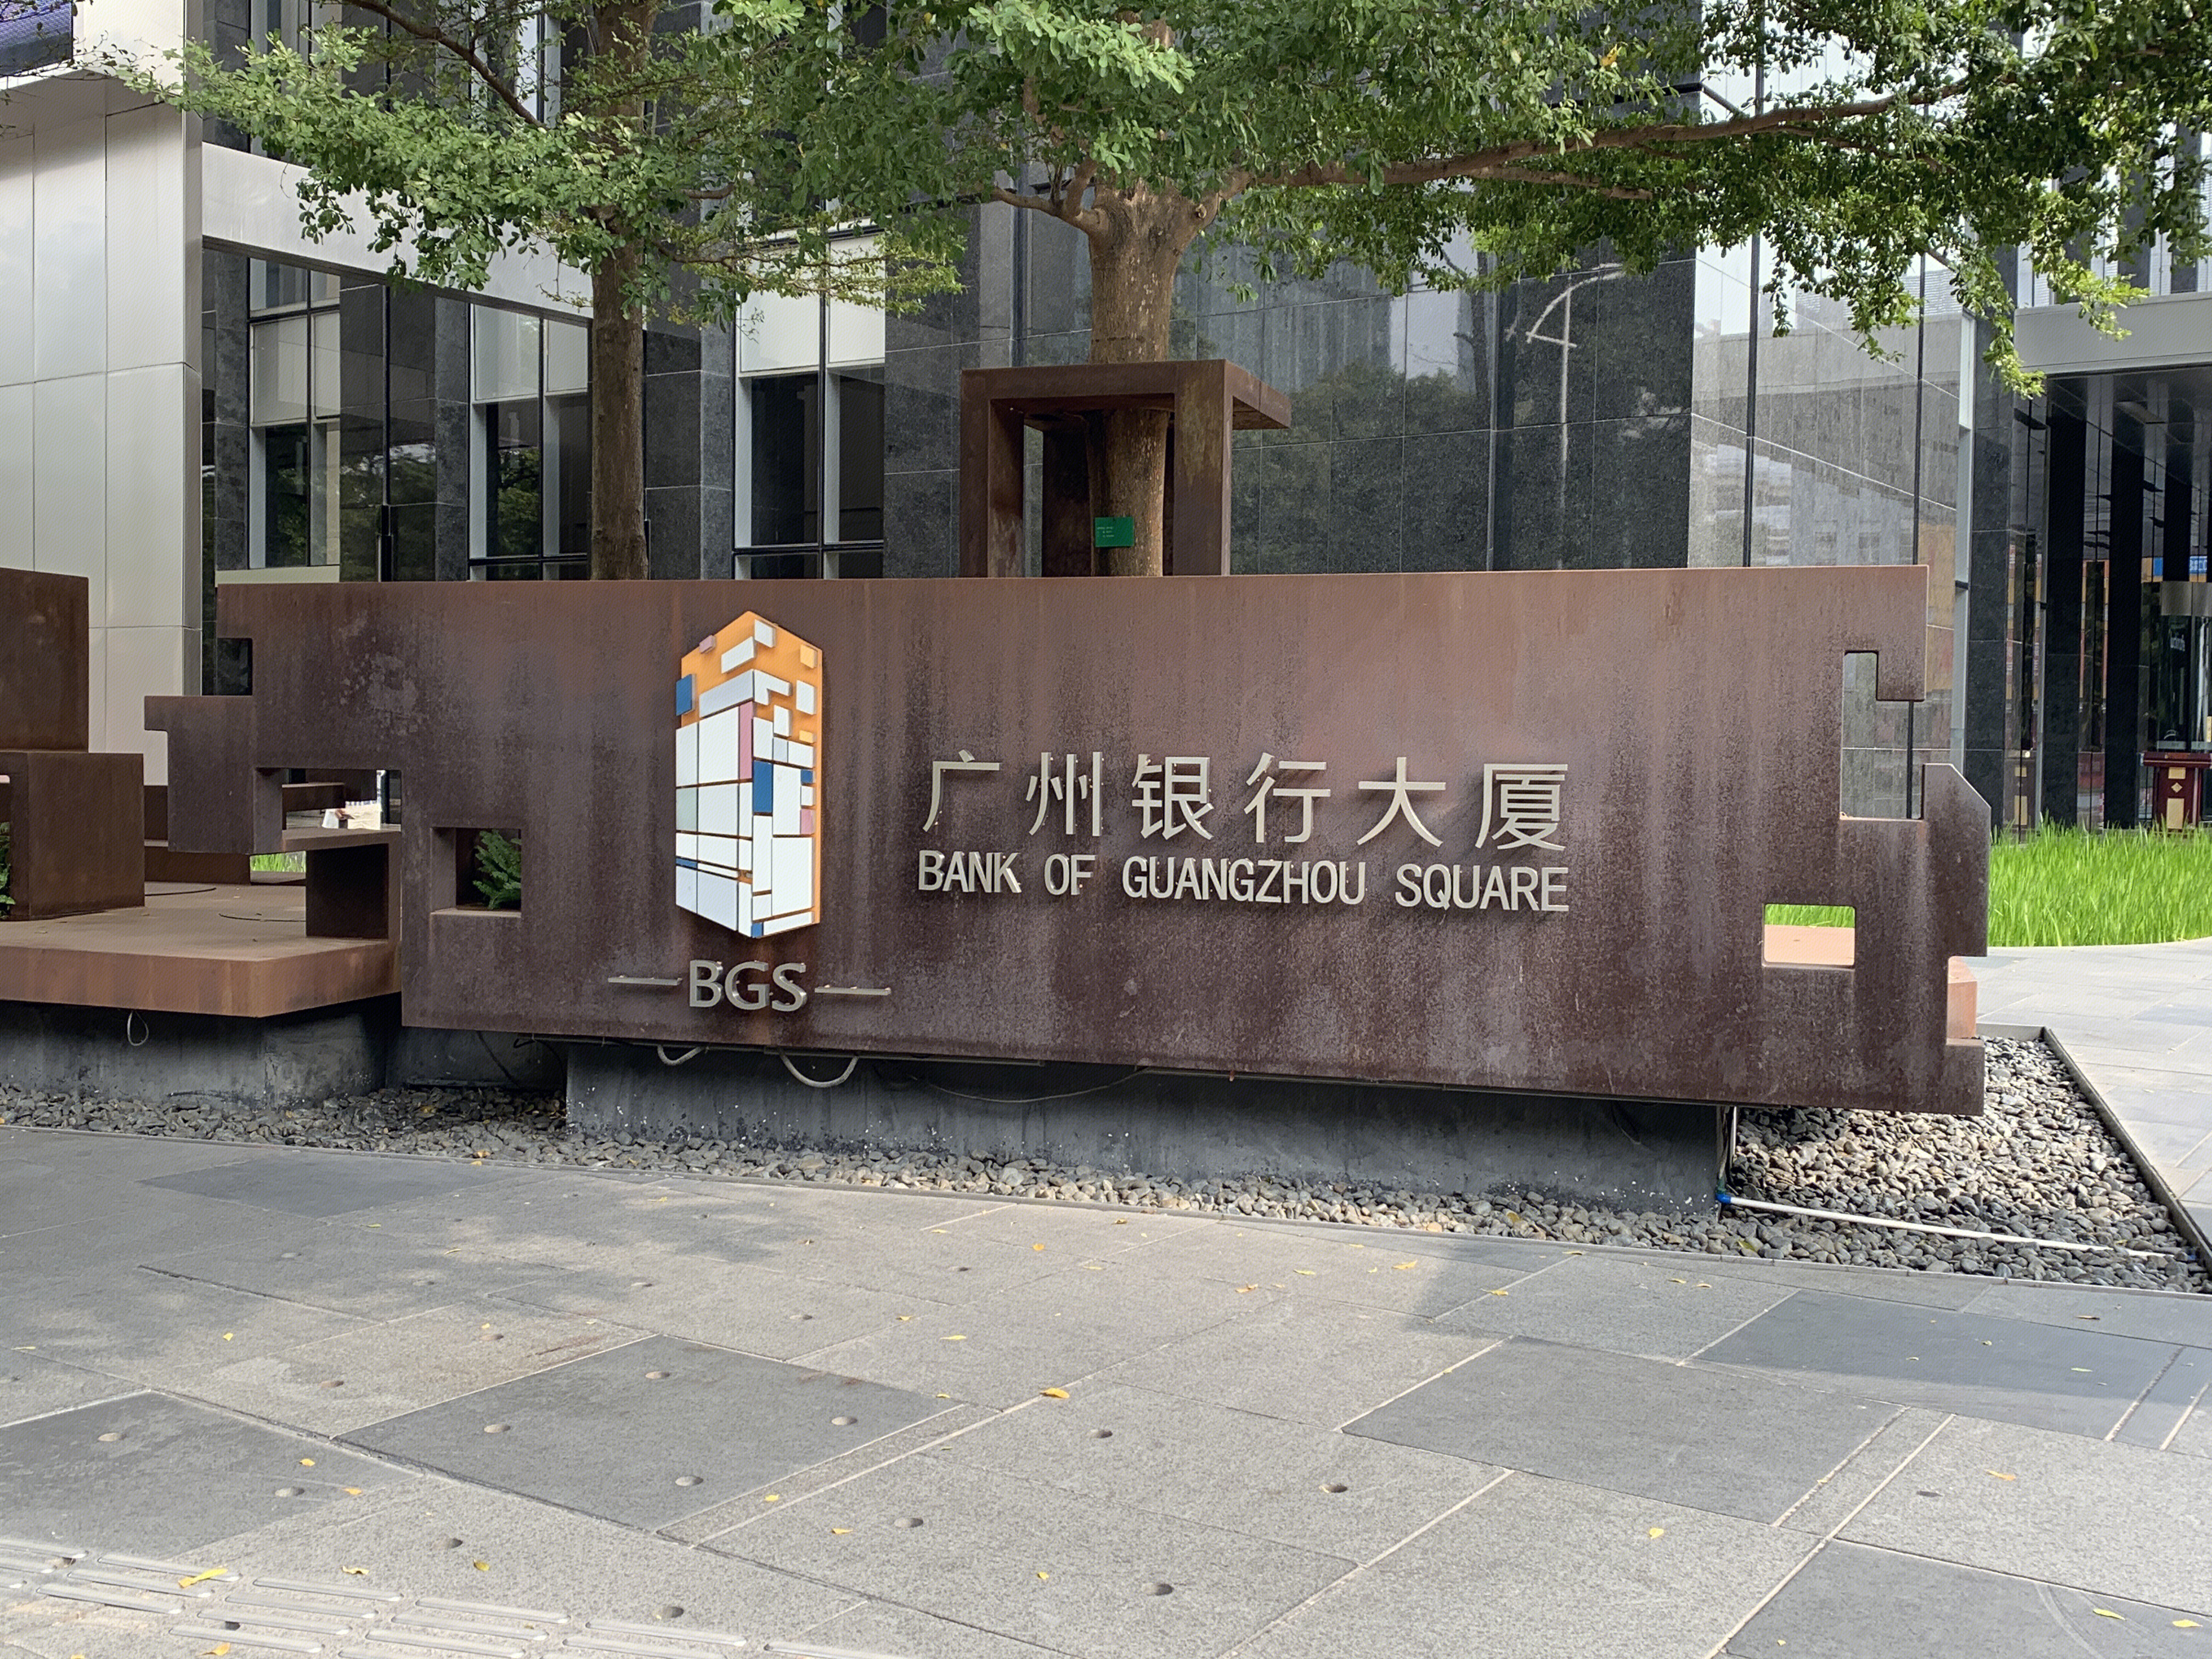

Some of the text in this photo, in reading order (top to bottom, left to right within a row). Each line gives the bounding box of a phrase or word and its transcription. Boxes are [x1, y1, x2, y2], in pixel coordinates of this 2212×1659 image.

[923, 749, 1568, 851] 广州银行大厦
[918, 850, 1569, 912] BANK OF GUANGZHOU SQUARE
[689, 960, 808, 1012] BGS
